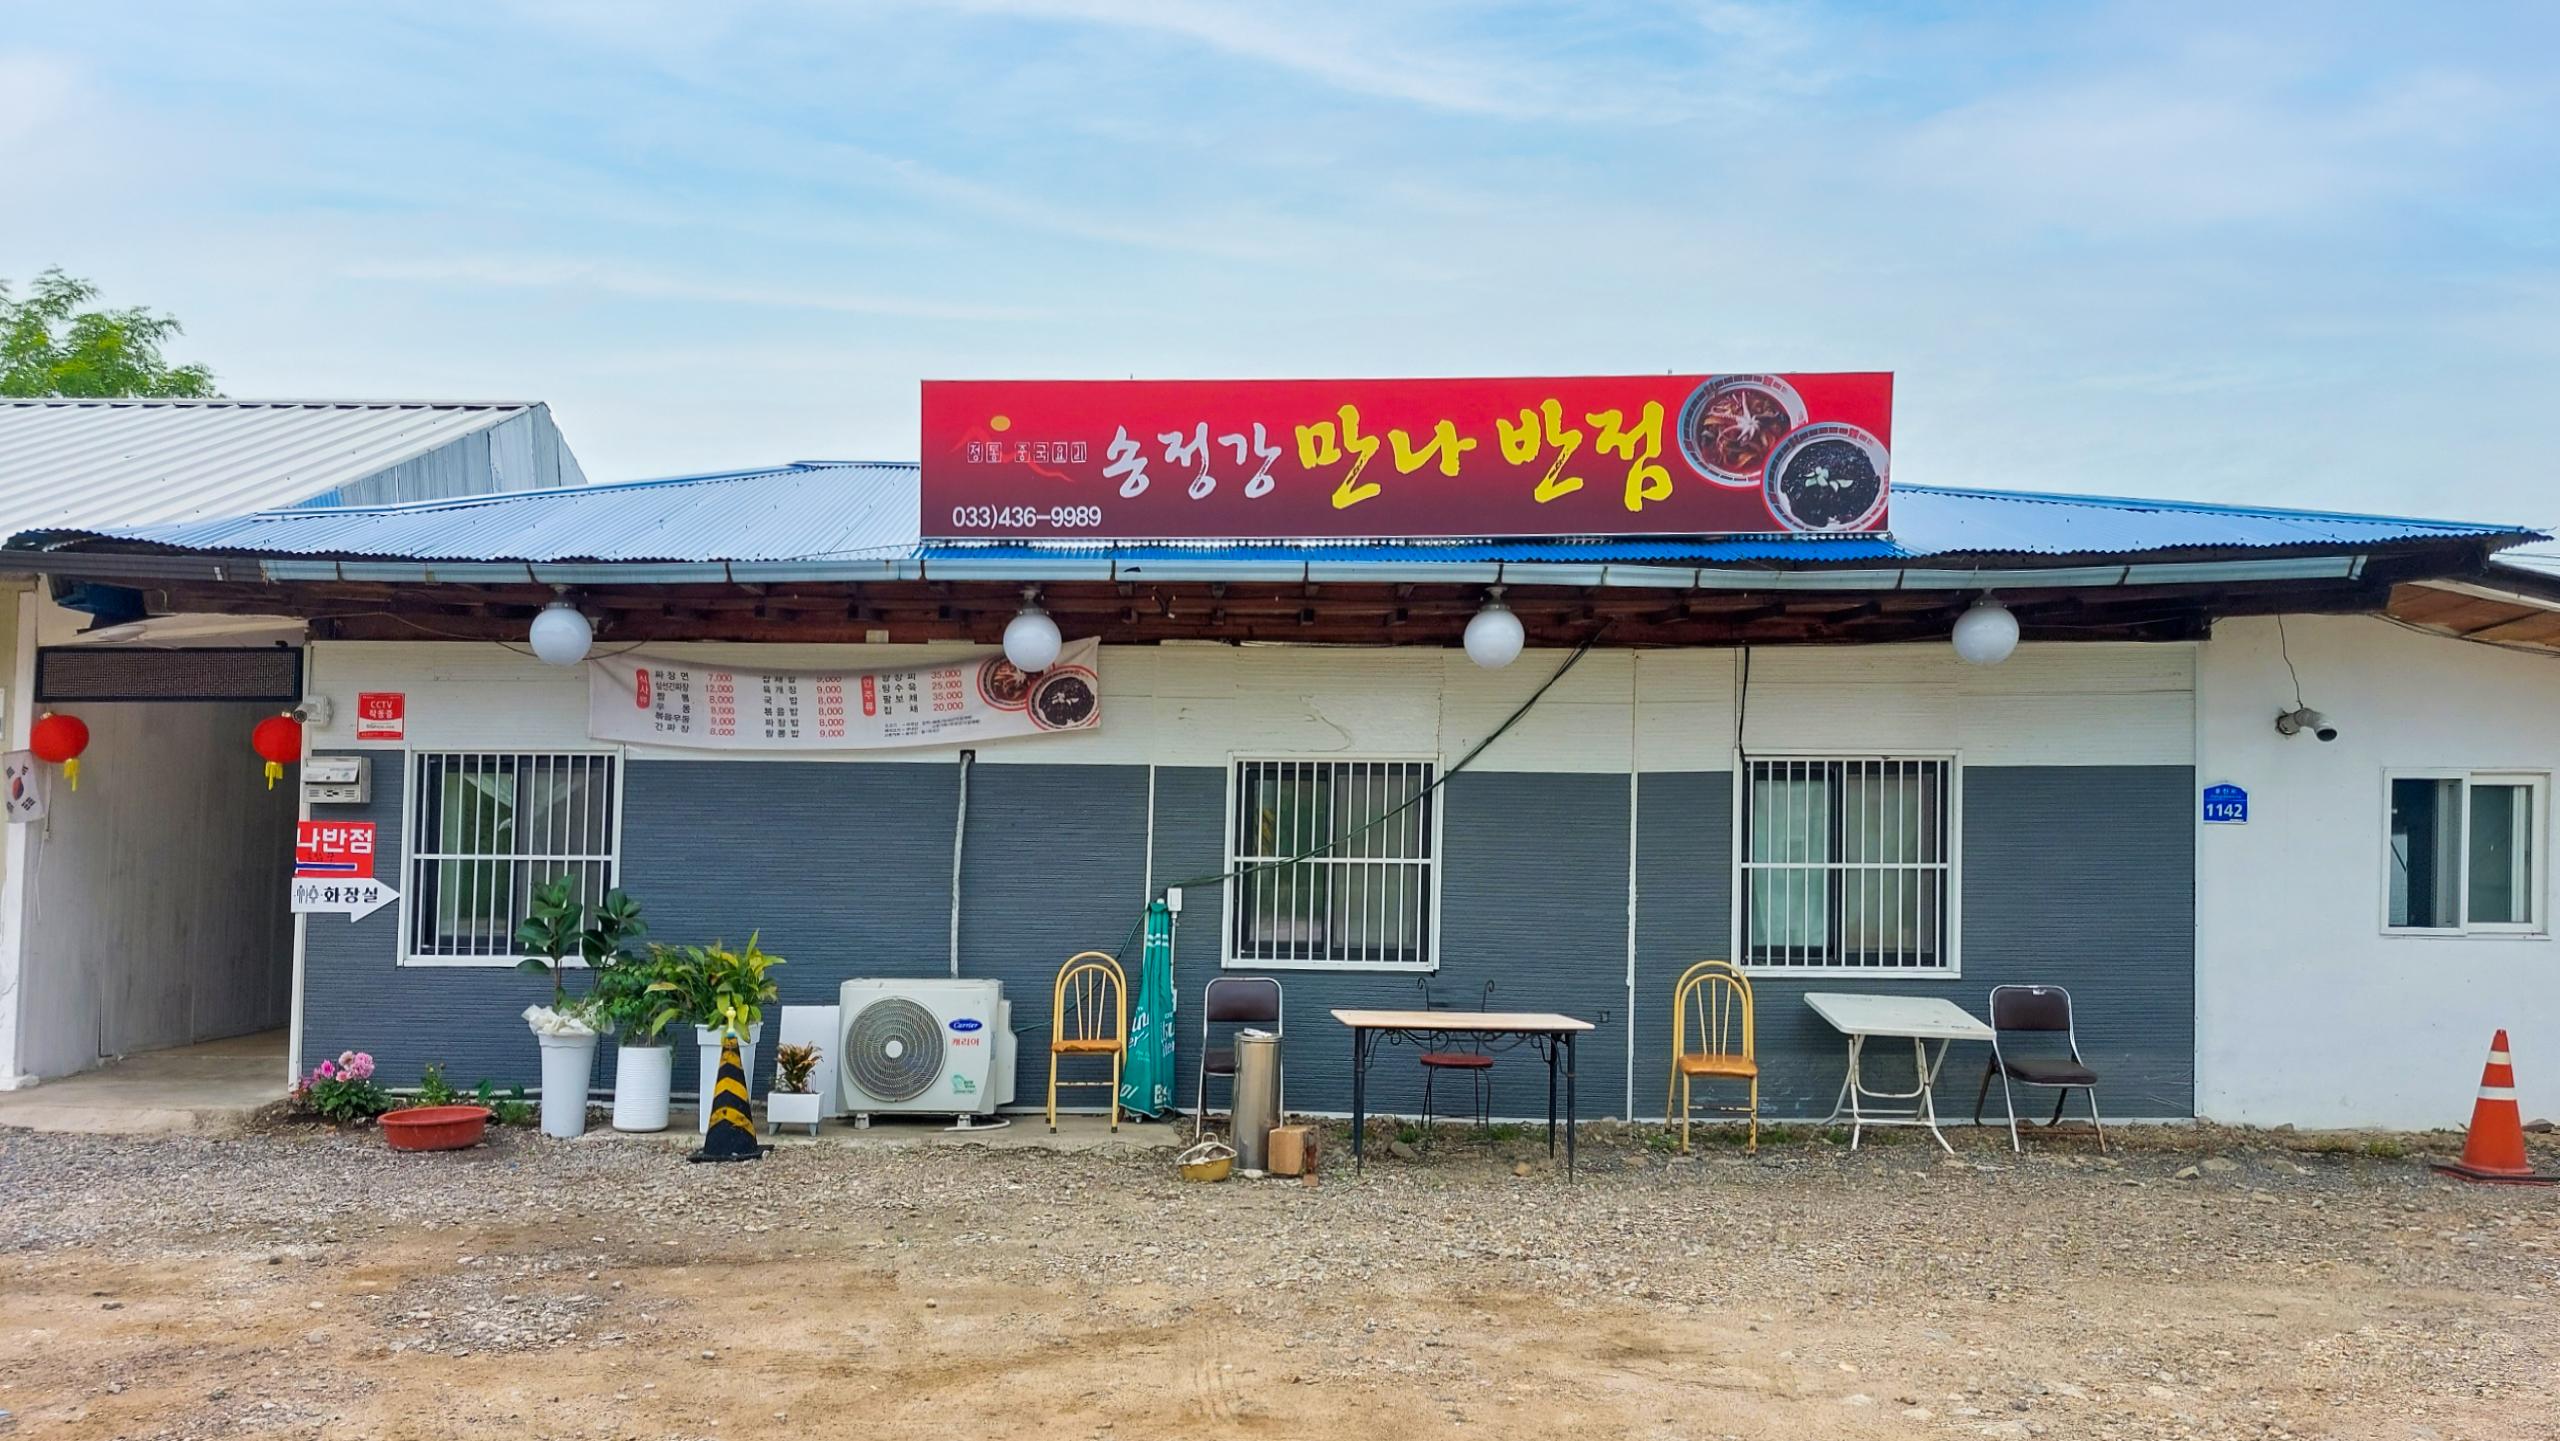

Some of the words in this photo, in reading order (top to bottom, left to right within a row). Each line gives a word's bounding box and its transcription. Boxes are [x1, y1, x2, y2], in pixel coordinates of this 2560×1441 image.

[968, 442, 1001, 462] 정통
[1015, 442, 1086, 462] 중국요리
[1103, 422, 1281, 499] 송정강
[1294, 404, 1477, 509] 만나
[1496, 398, 1673, 512] 반점
[952, 504, 1102, 529] 033)436-9989
[931, 669, 962, 679] 35,000
[705, 684, 733, 694] 12,000
[816, 685, 842, 694] 9,000
[931, 680, 962, 690] 25,000
[932, 691, 963, 701] 35,000
[370, 700, 393, 709] CCTV
[933, 701, 964, 712] 20,000
[369, 709, 393, 719] 작동중
[2206, 803, 2243, 817] 1142
[297, 827, 373, 854] 나반점
[323, 886, 378, 904] 화장실
[953, 1021, 979, 1029] Carrier
[952, 1038, 979, 1046] 캐리어
